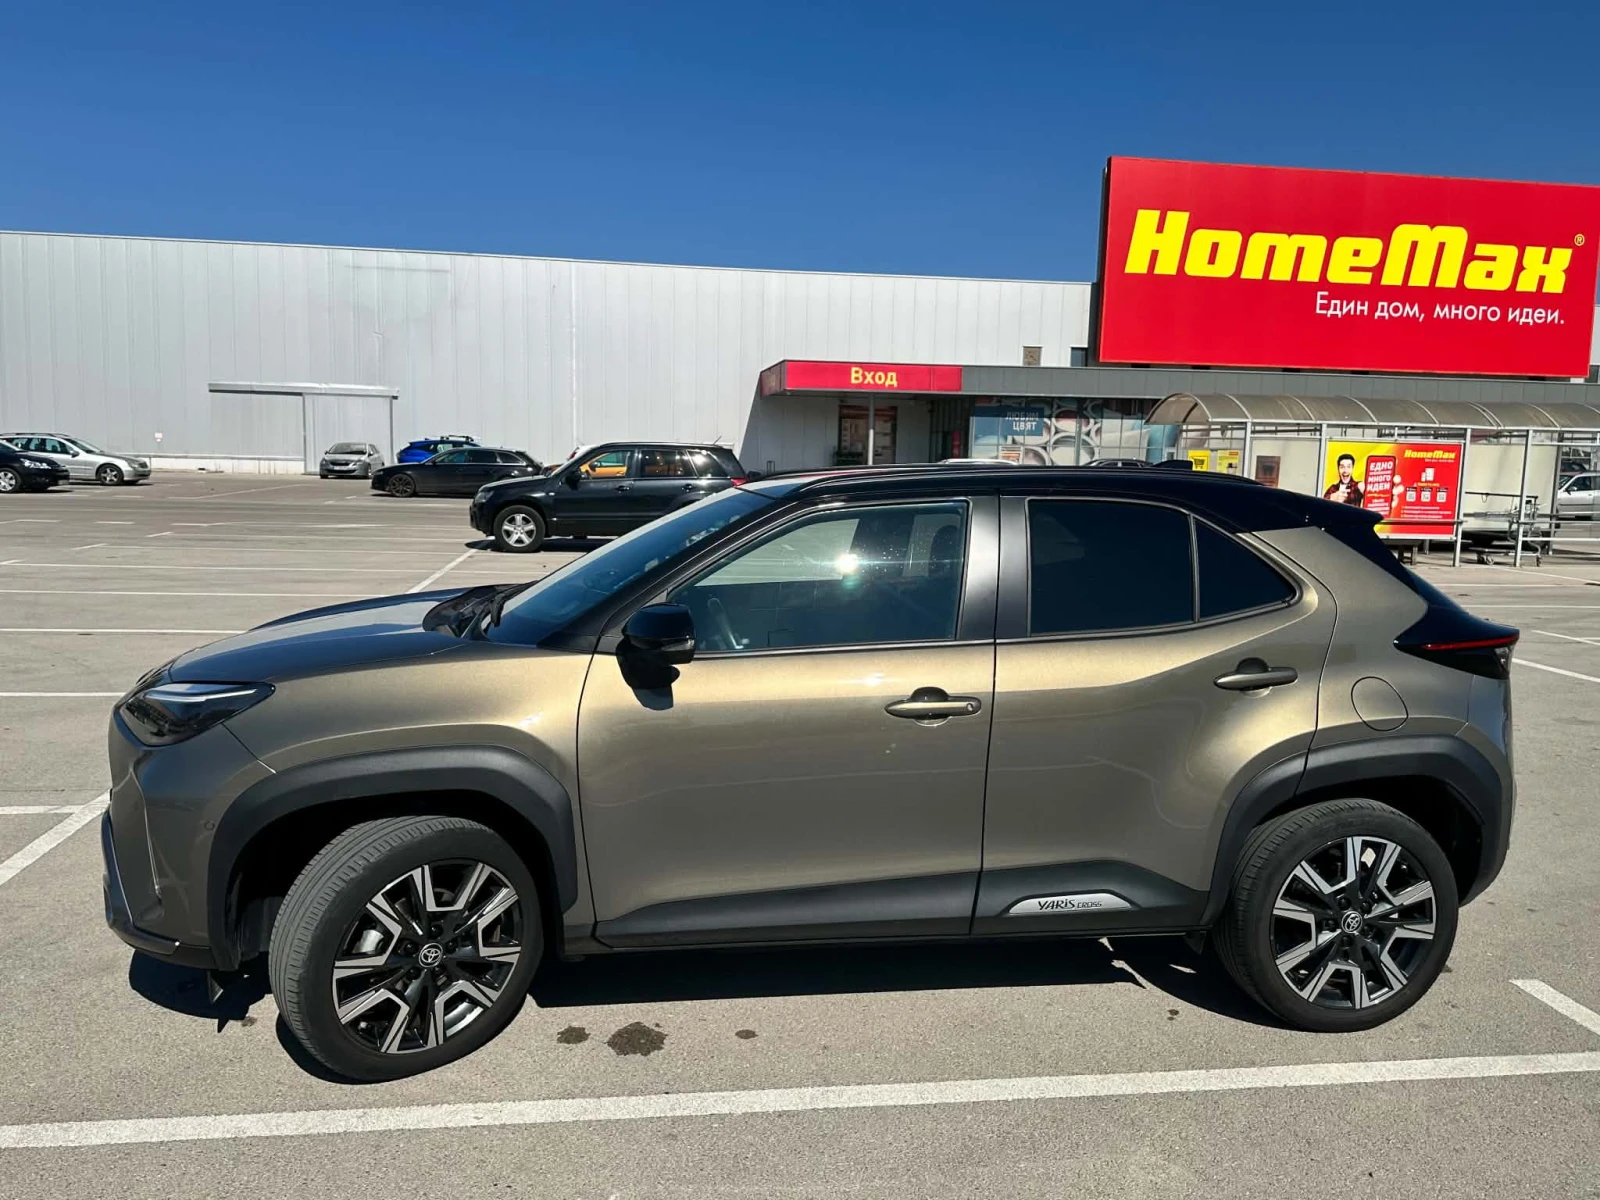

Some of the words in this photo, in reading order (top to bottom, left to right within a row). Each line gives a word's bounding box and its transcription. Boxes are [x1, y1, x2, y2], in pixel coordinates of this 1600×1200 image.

[1124, 208, 1573, 294] HomeMax
[1315, 291, 1369, 318] Един
[1374, 301, 1425, 322] дом,
[1433, 303, 1501, 322] много
[1507, 307, 1565, 325] идеи.
[850, 366, 898, 388] Вход
[1005, 411, 1039, 421] ЛЮБИМ
[1012, 421, 1037, 432] ЦВЯТ
[1404, 450, 1455, 459] HomeMax
[1370, 462, 1393, 471] ЕДНО
[1368, 475, 1391, 483] МНОГО
